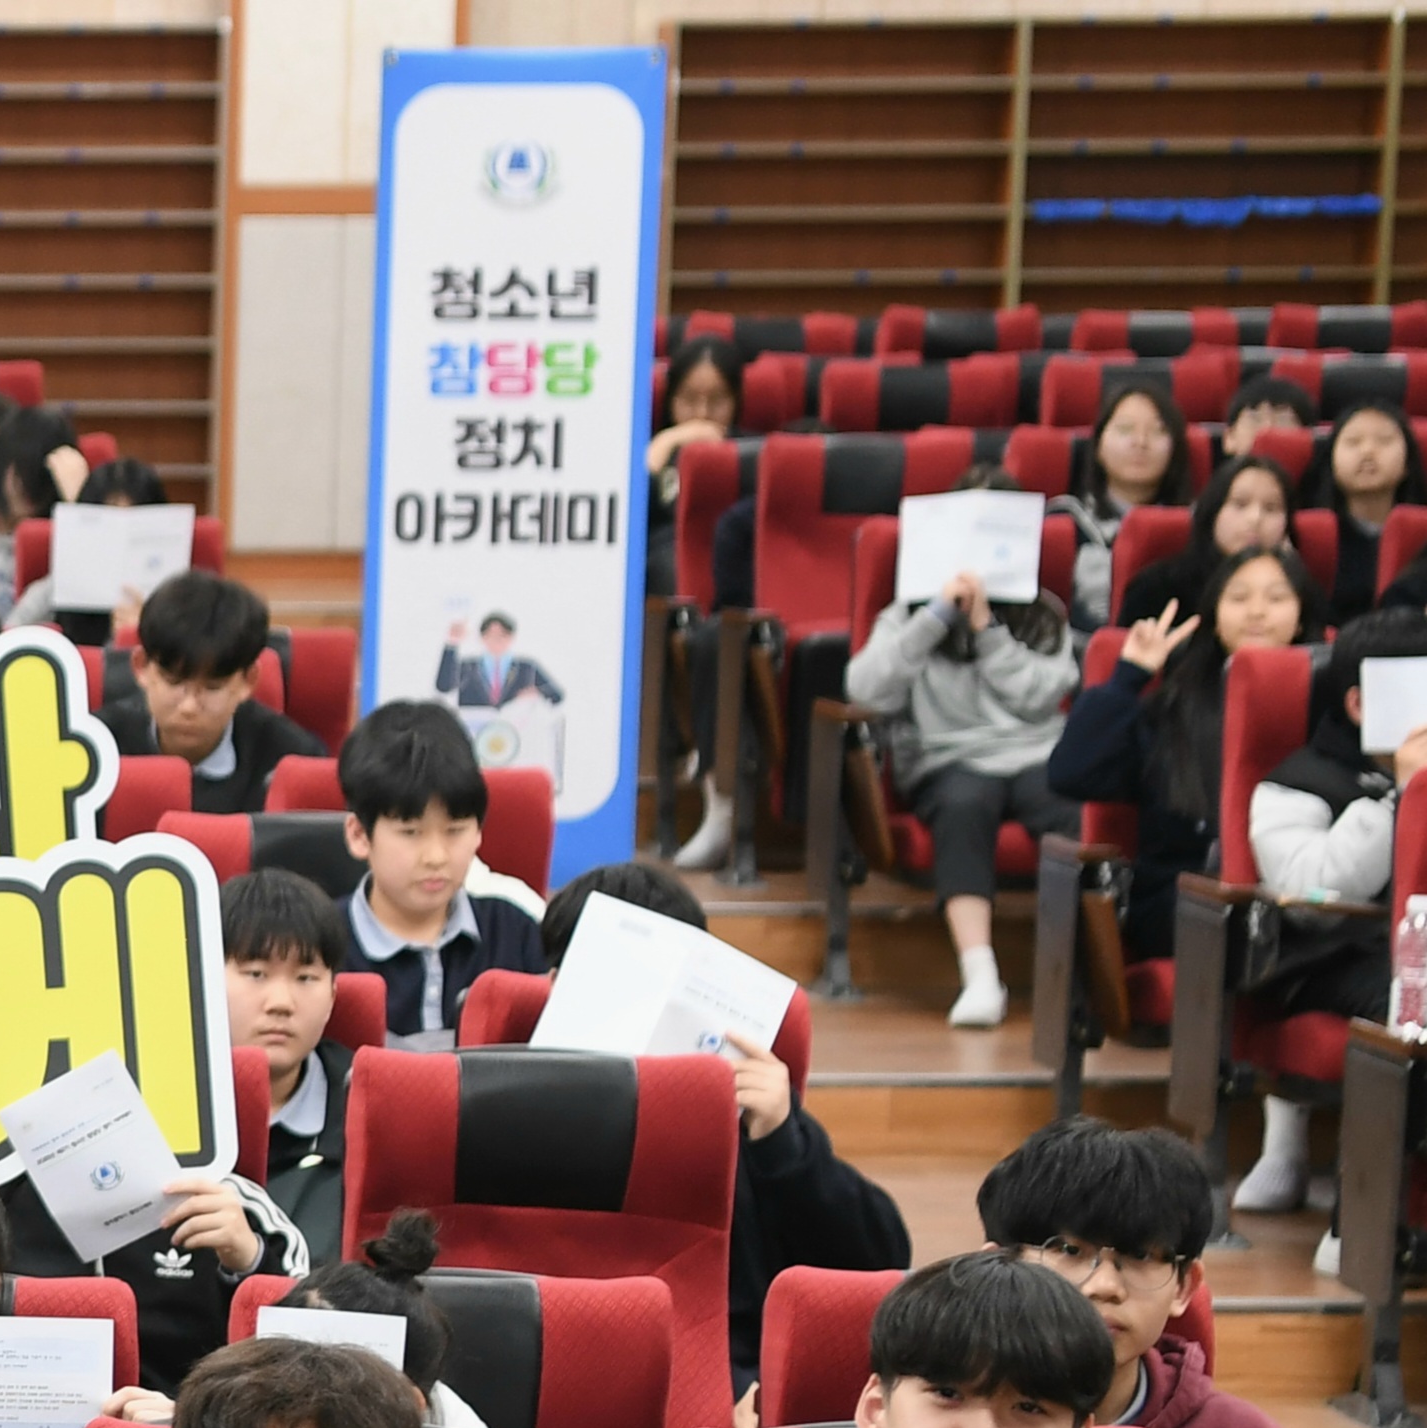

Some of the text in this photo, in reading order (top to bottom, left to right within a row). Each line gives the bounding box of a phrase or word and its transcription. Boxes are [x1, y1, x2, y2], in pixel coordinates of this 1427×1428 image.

[431, 266, 599, 320] 청소년
[429, 341, 599, 396] 참당당
[454, 417, 563, 470] 정치
[394, 491, 618, 546] 아카데미
